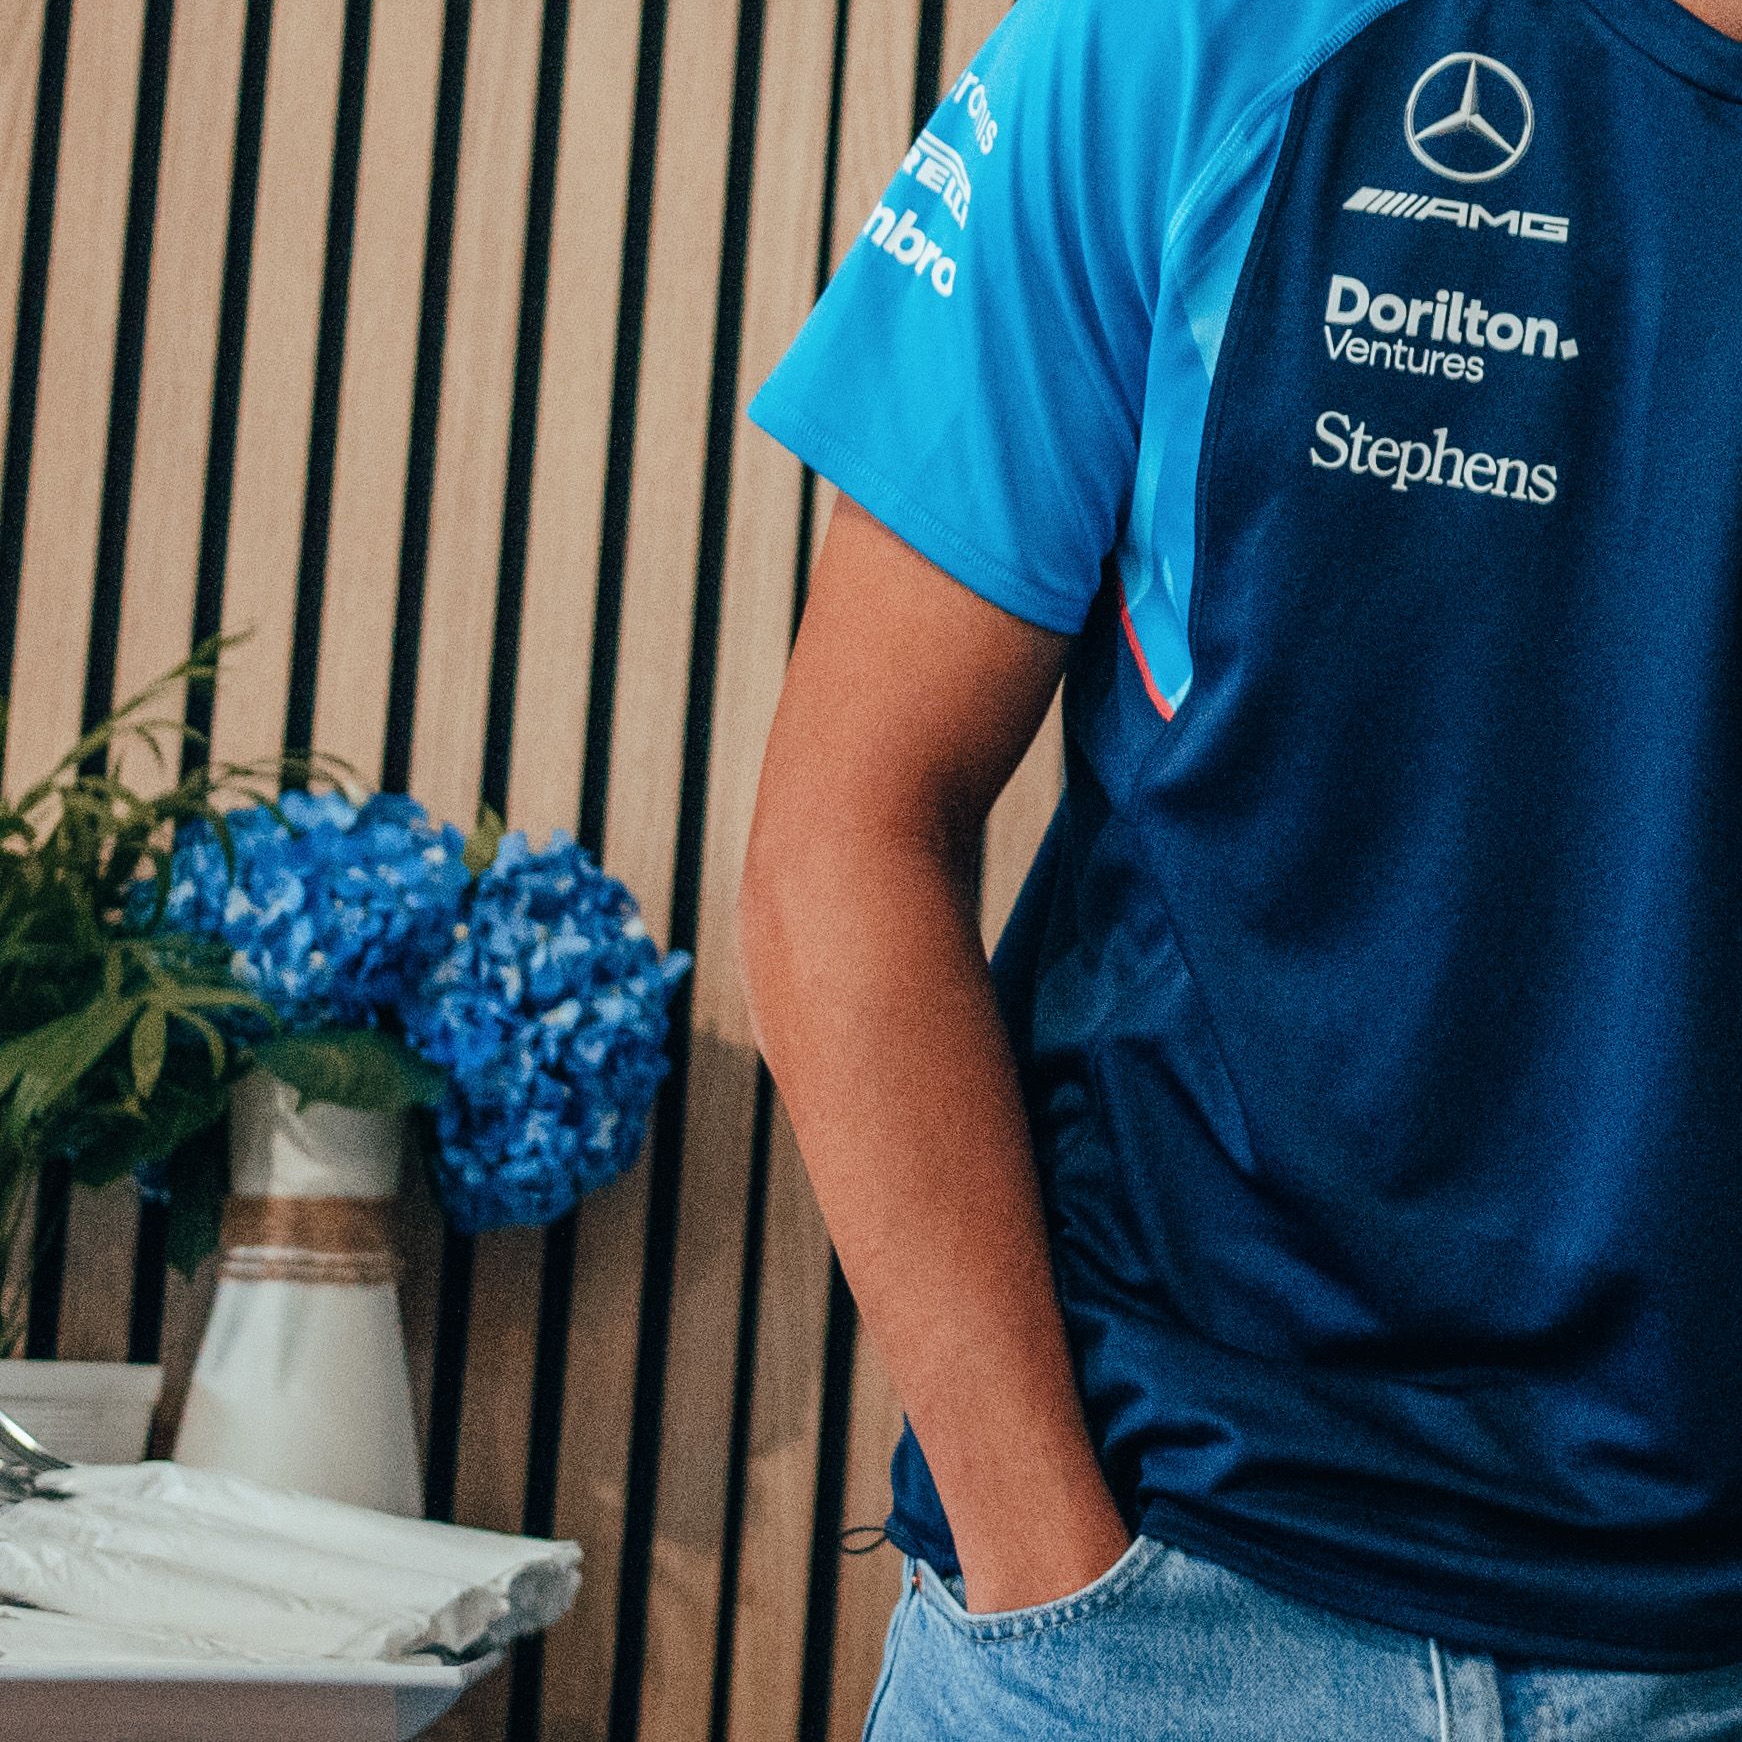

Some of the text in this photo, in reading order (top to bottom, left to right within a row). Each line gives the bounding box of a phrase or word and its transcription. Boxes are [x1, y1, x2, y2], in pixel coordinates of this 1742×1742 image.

[1416, 199, 1569, 243] AMG
[1324, 325, 1484, 383] Ventures
[1310, 411, 1558, 505] Stephens
